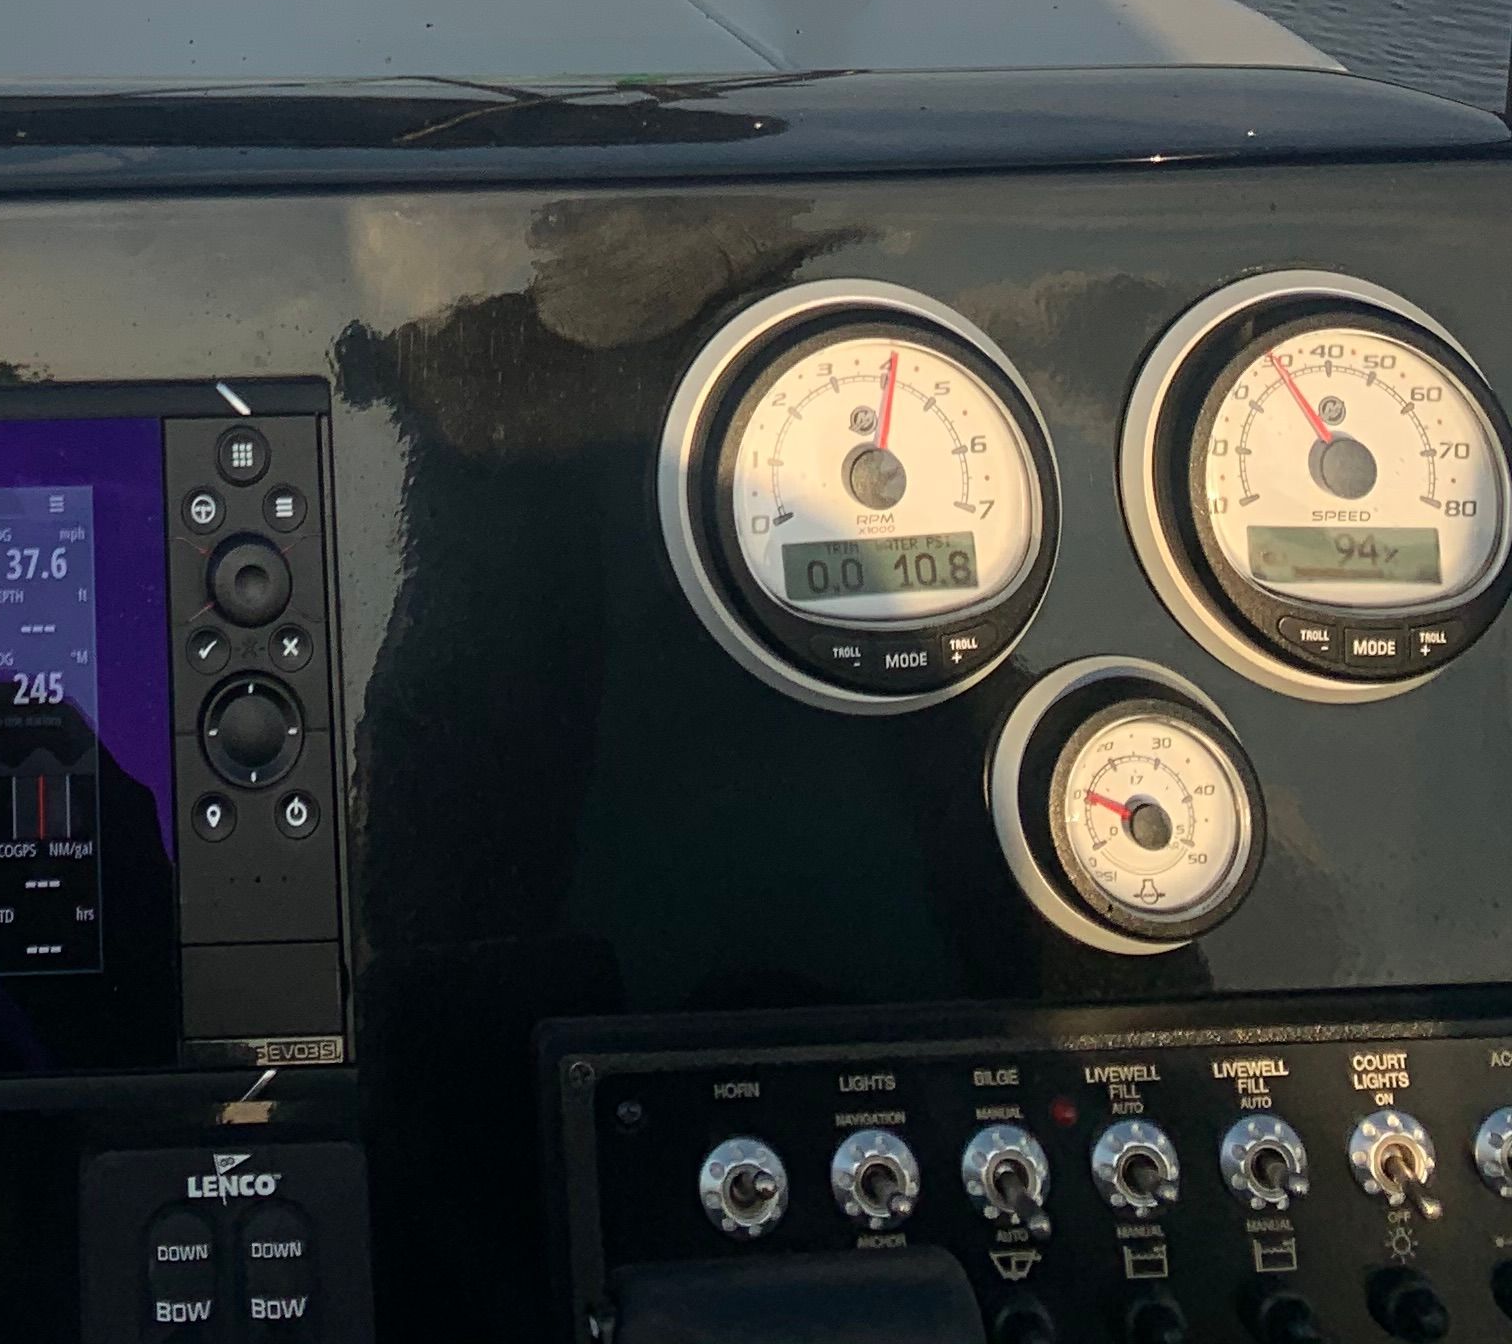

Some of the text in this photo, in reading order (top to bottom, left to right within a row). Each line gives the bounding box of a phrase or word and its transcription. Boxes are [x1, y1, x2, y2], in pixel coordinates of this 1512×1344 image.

[1310, 344, 1344, 359] 40
[818, 363, 833, 378] 3
[1363, 354, 1397, 370] 50
[934, 381, 950, 396] 5
[1410, 386, 1442, 402] 60
[771, 393, 787, 407] 2
[970, 436, 987, 453] 6
[1439, 442, 1471, 459] 70
[979, 500, 995, 519] 7
[1311, 510, 1371, 522] SPEED
[1444, 500, 1477, 517] 80
[751, 516, 770, 534] 0
[856, 514, 896, 526] RPM
[59, 526, 86, 544] mph
[6, 546, 68, 581] 37.6
[894, 549, 972, 588] 10.8
[949, 635, 979, 651] TROLL
[1300, 628, 1330, 642] TROLL
[1419, 631, 1447, 645] TROLL
[833, 645, 861, 659] TROLL
[1352, 639, 1397, 657] MODE
[884, 651, 929, 669] MODE
[12, 671, 65, 706] 245
[1096, 741, 1114, 753] 20
[1151, 737, 1172, 750] 30
[1193, 784, 1215, 797] 40
[49, 841, 93, 860] NM/gal
[1188, 853, 1208, 865] 50
[75, 905, 95, 922] hrs
[1352, 1053, 1408, 1072] COURT
[1491, 1050, 1512, 1068] AC
[973, 1067, 1020, 1087] BILGE
[1085, 1065, 1161, 1085] LIVEWELL
[1212, 1059, 1290, 1079] LIVEWELL
[838, 1073, 896, 1093] LIGHTS
[1237, 1077, 1270, 1095] FILL
[1353, 1070, 1411, 1091] LIGHTS
[713, 1081, 760, 1100] HORN
[1108, 1082, 1141, 1100] FILL
[1374, 1092, 1395, 1107] ON
[1111, 1101, 1145, 1115] AUTO
[1239, 1096, 1273, 1110] AUTO
[188, 1173, 277, 1199] LENCO
[156, 1243, 209, 1262] DOWN
[251, 1240, 302, 1259] DOWN
[155, 1300, 212, 1323] BOW
[250, 1297, 308, 1320] BOW
